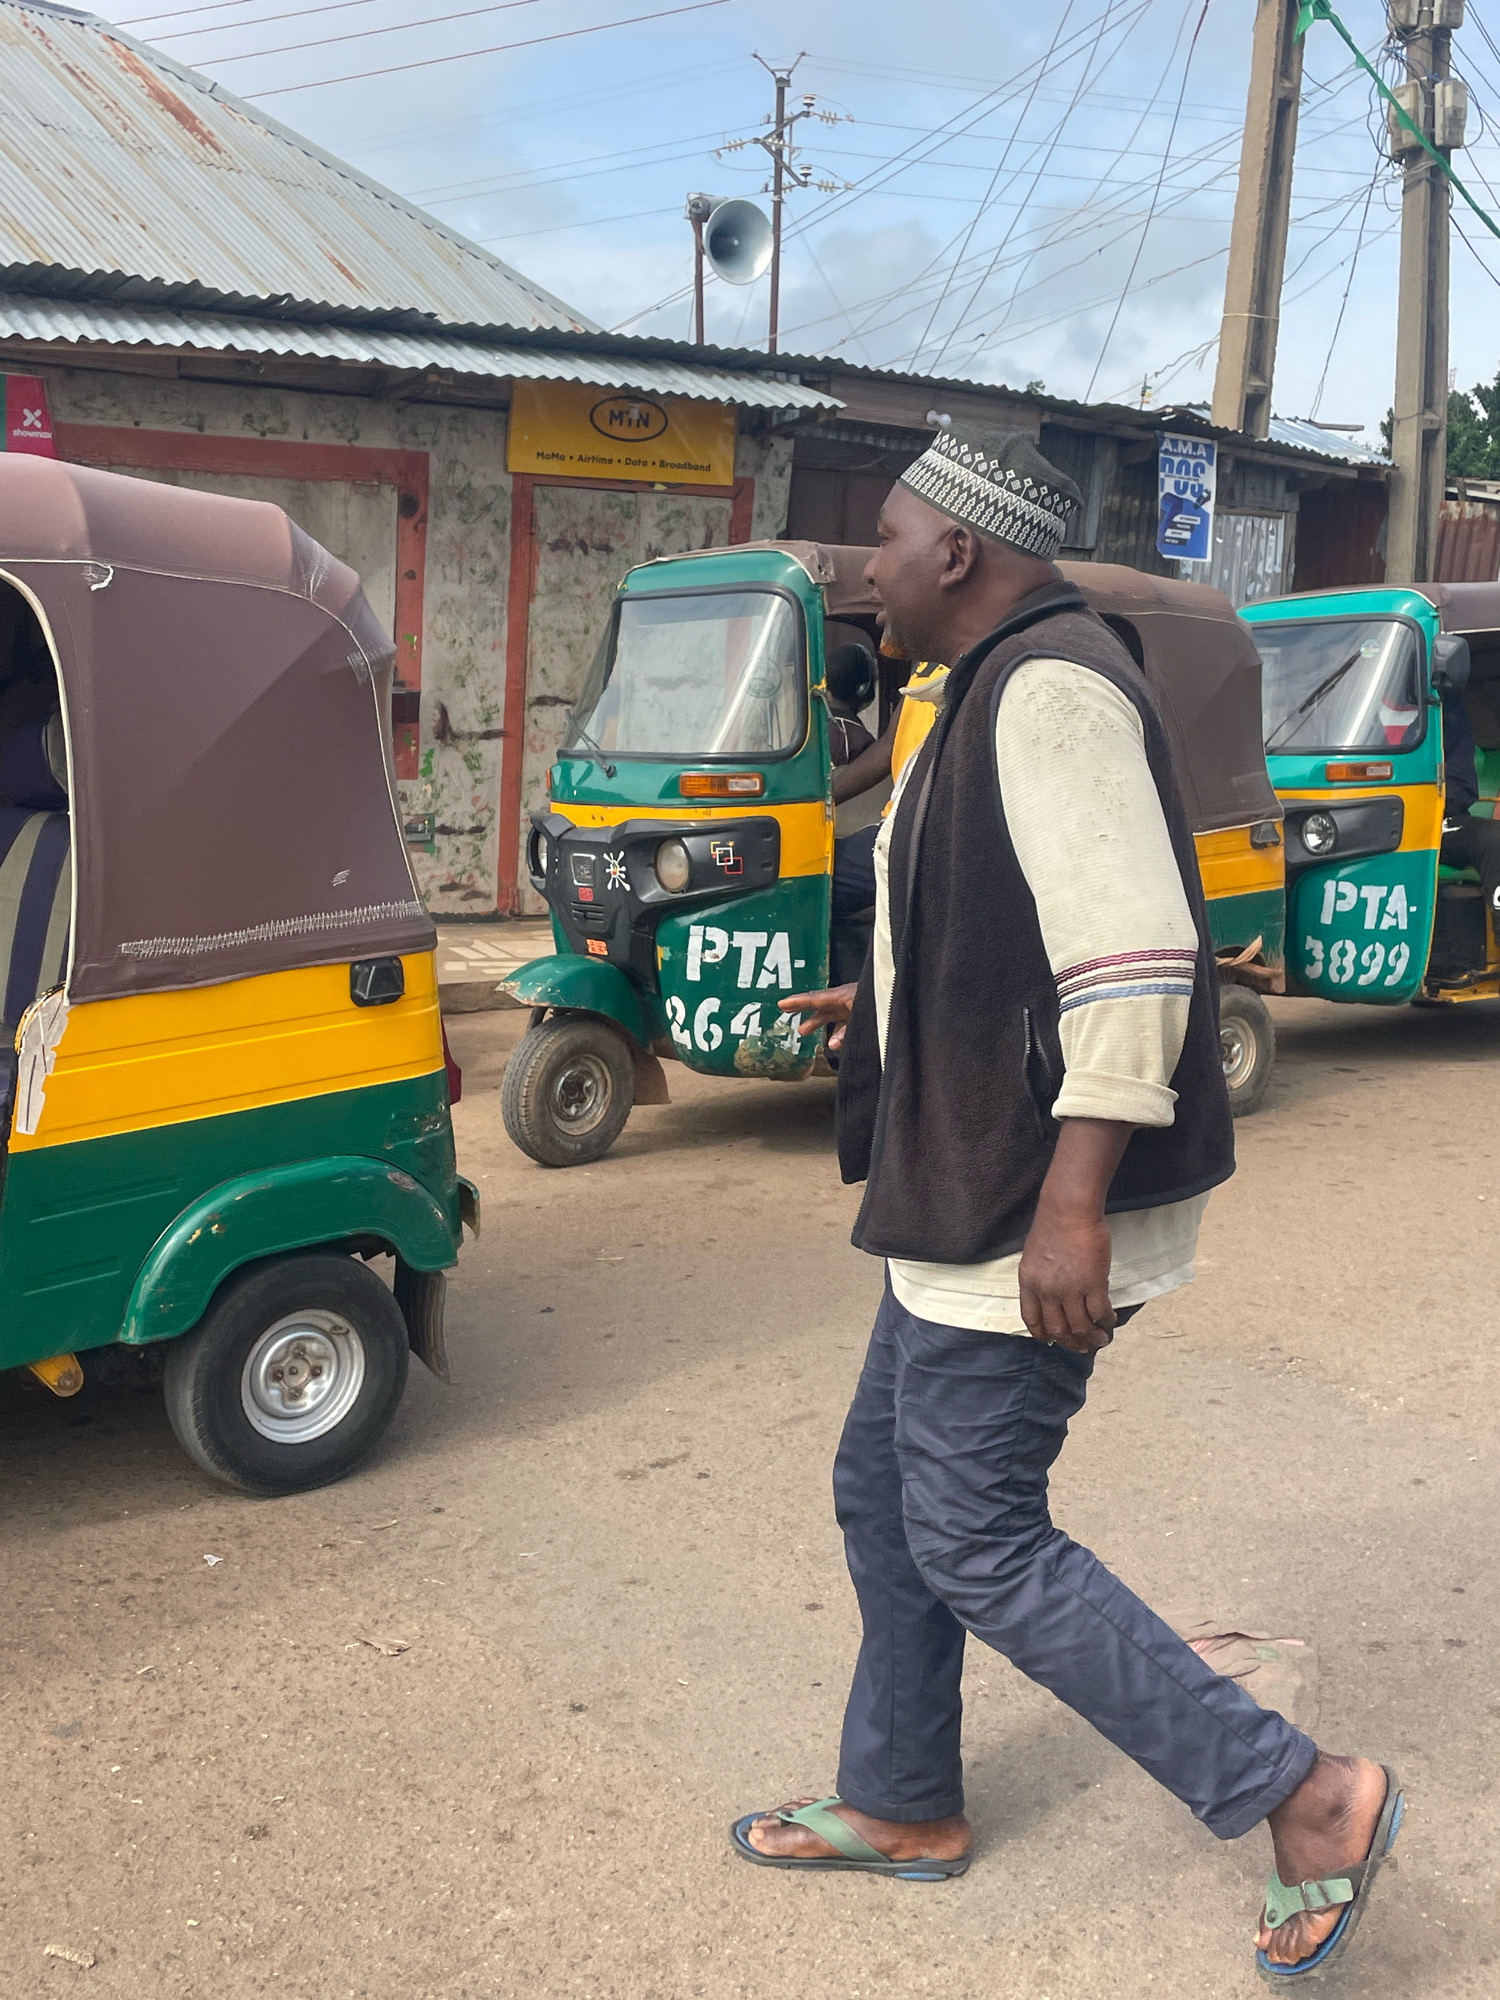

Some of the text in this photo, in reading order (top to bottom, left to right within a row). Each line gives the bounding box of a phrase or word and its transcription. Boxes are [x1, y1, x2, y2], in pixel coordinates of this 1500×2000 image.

[12, 428, 52, 439] showmax
[1160, 438, 1207, 457] A.M.A
[536, 451, 711, 472] MoMo Airtime Data Broadband
[1160, 457, 1205, 497] POS
[1304, 935, 1410, 987] 3899
[665, 995, 802, 1056] 2644
